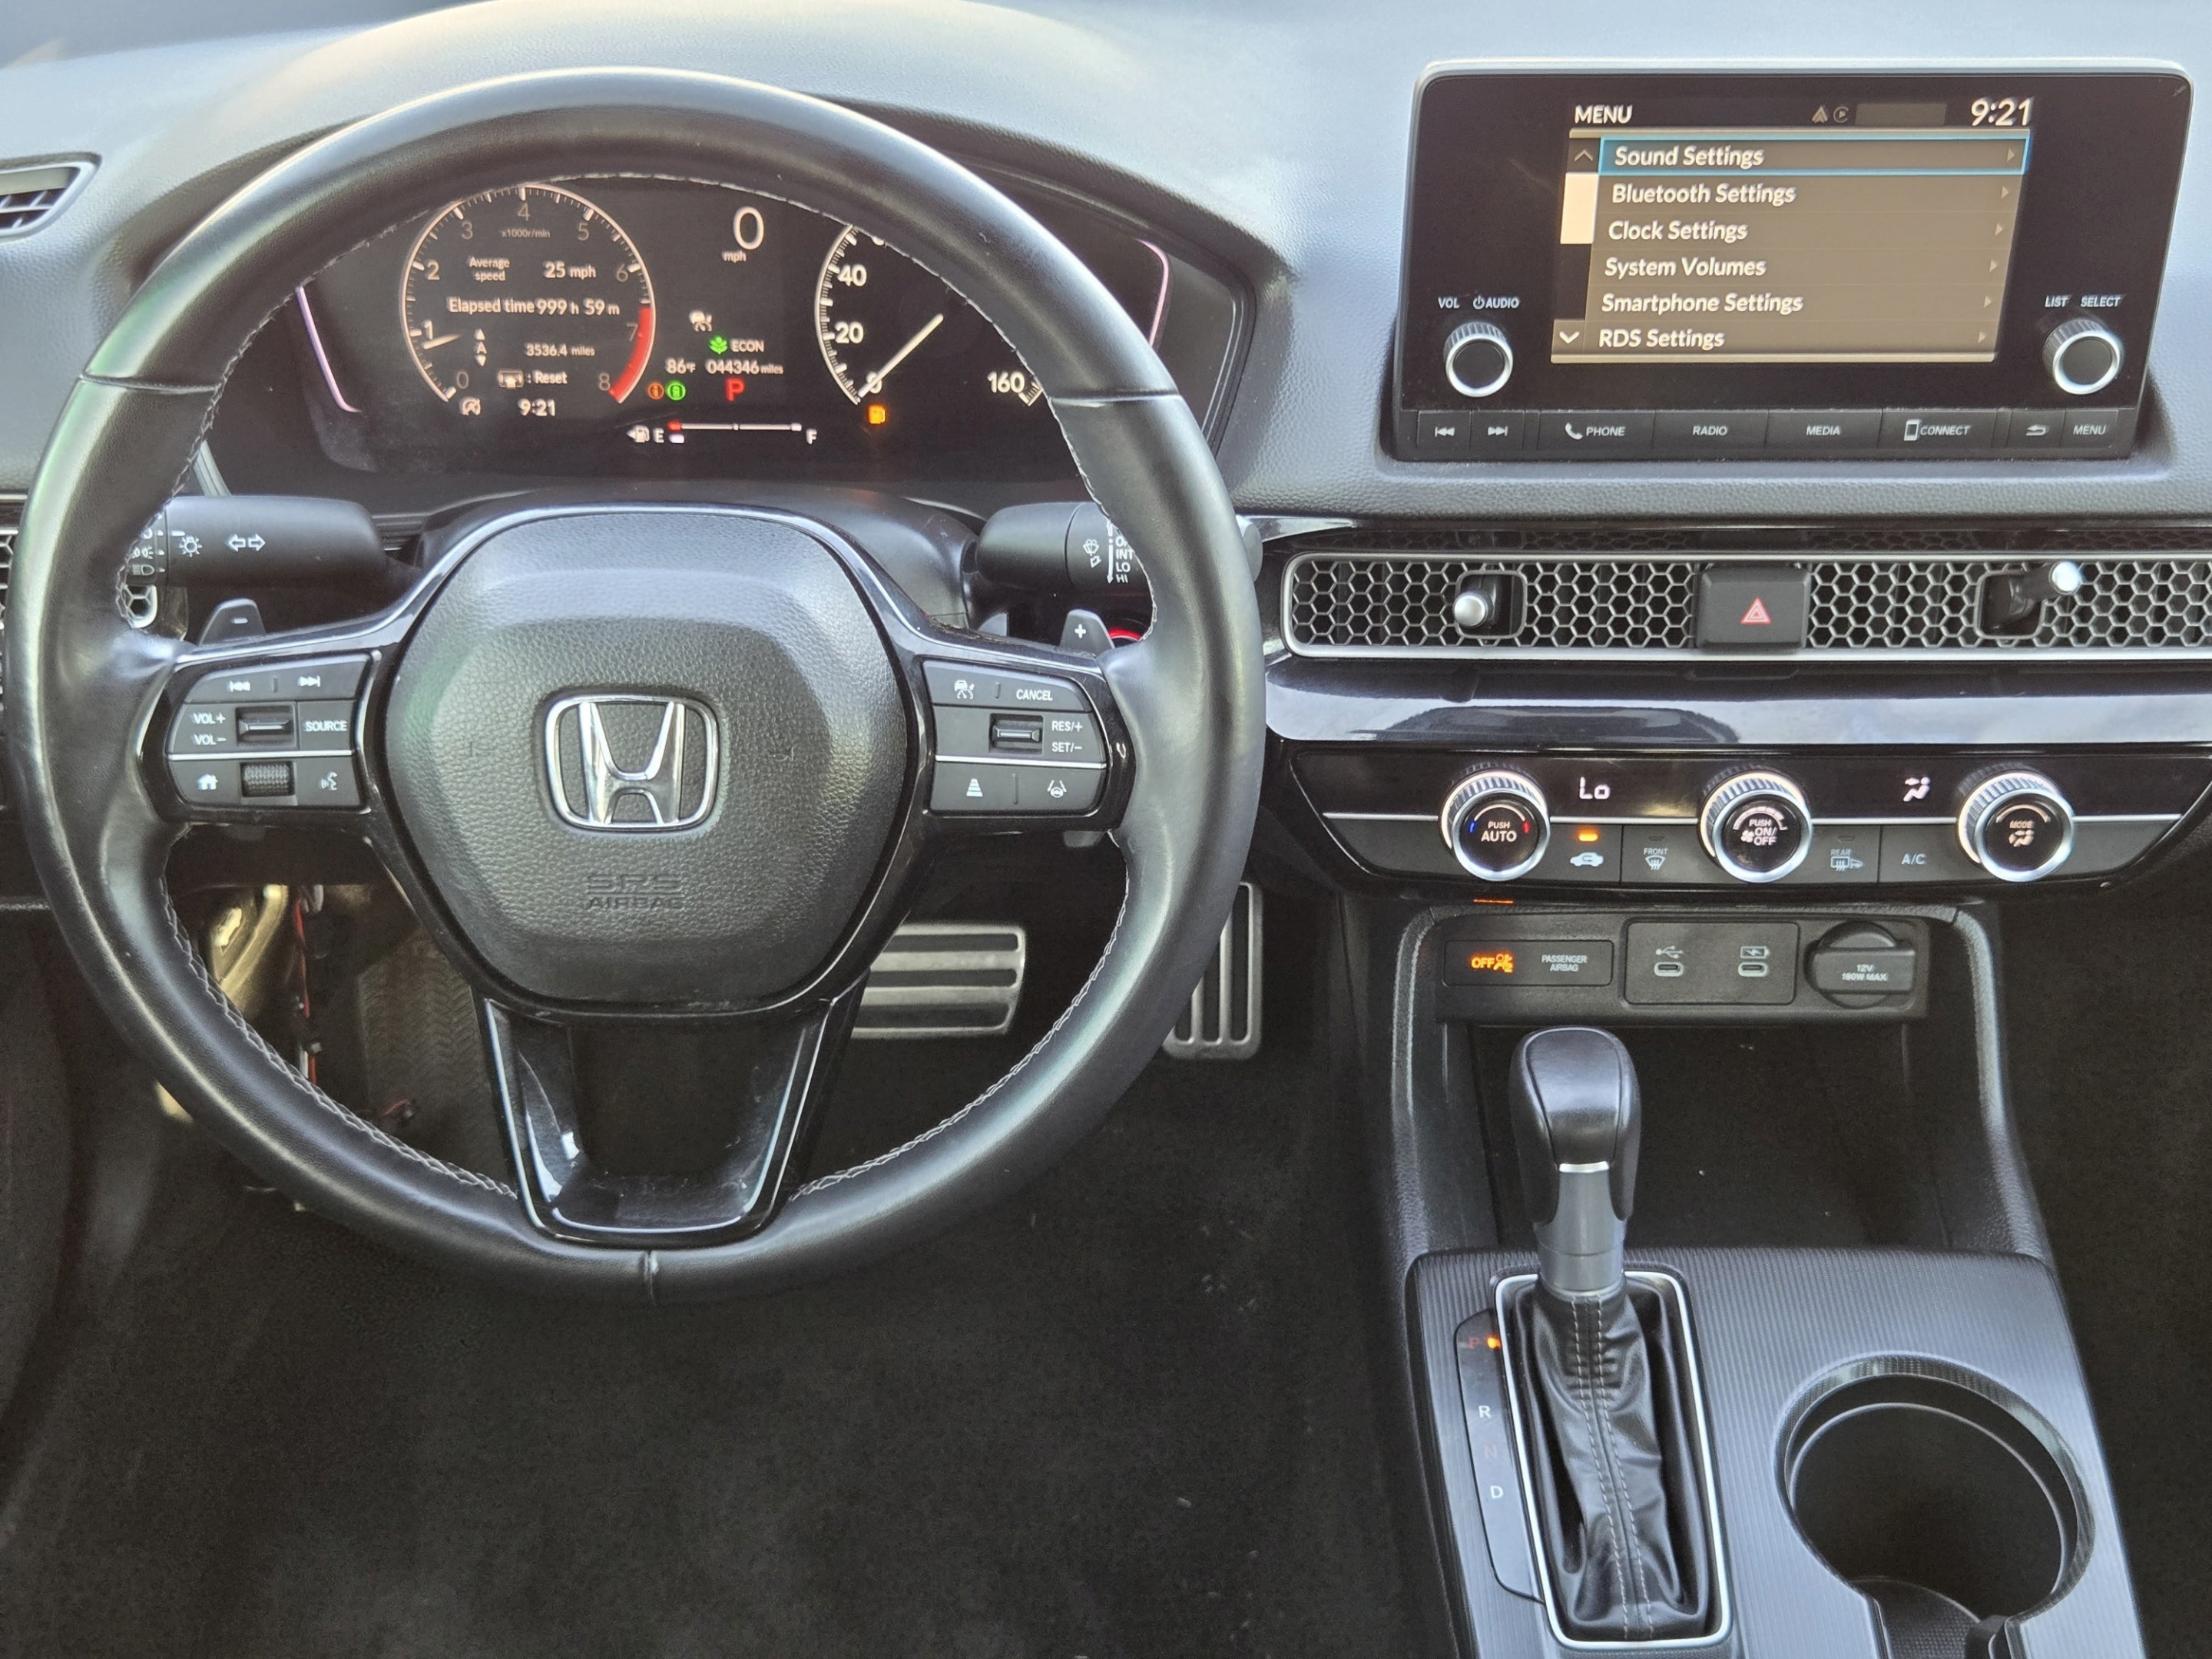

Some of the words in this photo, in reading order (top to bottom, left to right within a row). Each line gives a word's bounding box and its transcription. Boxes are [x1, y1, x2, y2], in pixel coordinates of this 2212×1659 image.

[1574, 105, 1633, 124] MENU
[1971, 97, 2033, 127] 9:21
[1614, 146, 1678, 167] Sound
[1683, 146, 1764, 170] Settings
[1612, 184, 1711, 205] Bluetooth
[1715, 184, 1796, 207] Settings
[518, 203, 530, 220] 4
[462, 222, 473, 240] 3
[502, 229, 550, 238] x1000r/min
[578, 223, 589, 240] 5
[733, 206, 764, 250] 0
[1608, 220, 1664, 241] Clock
[1667, 220, 1749, 243] Settings
[469, 257, 510, 270] Average
[721, 250, 747, 264] mph
[426, 260, 440, 280] 2
[545, 261, 565, 278] 25
[570, 264, 596, 279] mph
[617, 264, 628, 282] 6
[836, 264, 867, 286] 40
[1604, 257, 1677, 279] System
[1681, 257, 1767, 277] Volumes
[474, 271, 505, 283] speed
[448, 297, 501, 314] Elapsed
[504, 298, 535, 313] time
[537, 298, 567, 315] 999
[570, 298, 579, 315] h
[584, 298, 604, 315] 59
[608, 303, 620, 315] m
[1438, 296, 1460, 309] VOL
[1485, 296, 1520, 309] AUDIO
[1601, 293, 1720, 315] Smartphone
[1724, 292, 1803, 315] Settings
[2045, 295, 2070, 307] LIST
[2080, 295, 2123, 307] SELECT
[423, 320, 433, 339] 1
[626, 323, 638, 342] 7
[834, 322, 864, 344] 20
[730, 339, 764, 353] ECON
[1598, 329, 1642, 348] RDS
[1646, 329, 1725, 349] Settings
[525, 344, 568, 357] 3536.4
[571, 346, 595, 356] miles
[705, 359, 760, 375] 044346
[760, 364, 784, 374] miles
[456, 370, 469, 389] 0
[533, 371, 568, 385] Reset
[598, 373, 611, 392] 8
[988, 371, 1025, 393] 160
[726, 377, 746, 401] P
[518, 398, 555, 416] 9:21
[654, 428, 664, 444] E
[806, 429, 817, 445] F
[1586, 426, 1626, 436] PHONE
[1692, 426, 1728, 436] RADIO
[1806, 425, 1840, 436] MEDIA
[1920, 425, 1972, 436] CONNECT
[2073, 425, 2107, 435] MENU
[1116, 548, 1134, 560] INT
[1115, 561, 1131, 572] LO
[1116, 574, 1128, 583] HI
[1016, 689, 1053, 701] CANCEL
[304, 720, 348, 732] SOURCE
[1051, 720, 1083, 732] RES/+
[1578, 777, 1611, 800] Lo
[1488, 821, 1511, 830] PUSH
[1749, 818, 1772, 826] PUSH
[2009, 820, 2035, 829] MODE
[1481, 831, 1518, 843] AUTO
[1754, 827, 1777, 836] ON/
[1753, 836, 1777, 846] OFF
[1643, 847, 1669, 856] FRONT
[1830, 849, 1851, 857] REAR
[1901, 853, 1926, 865] A/C
[586, 896, 685, 910] AIRBAG
[1471, 956, 1494, 969] OFF
[1541, 955, 1588, 964] PASSENGER
[1550, 963, 1579, 972] AIRBAG
[1856, 964, 1874, 972] 12V
[1866, 972, 1888, 981] MAX
[1479, 1405, 1491, 1419] R
[1490, 1485, 1504, 1499] D
